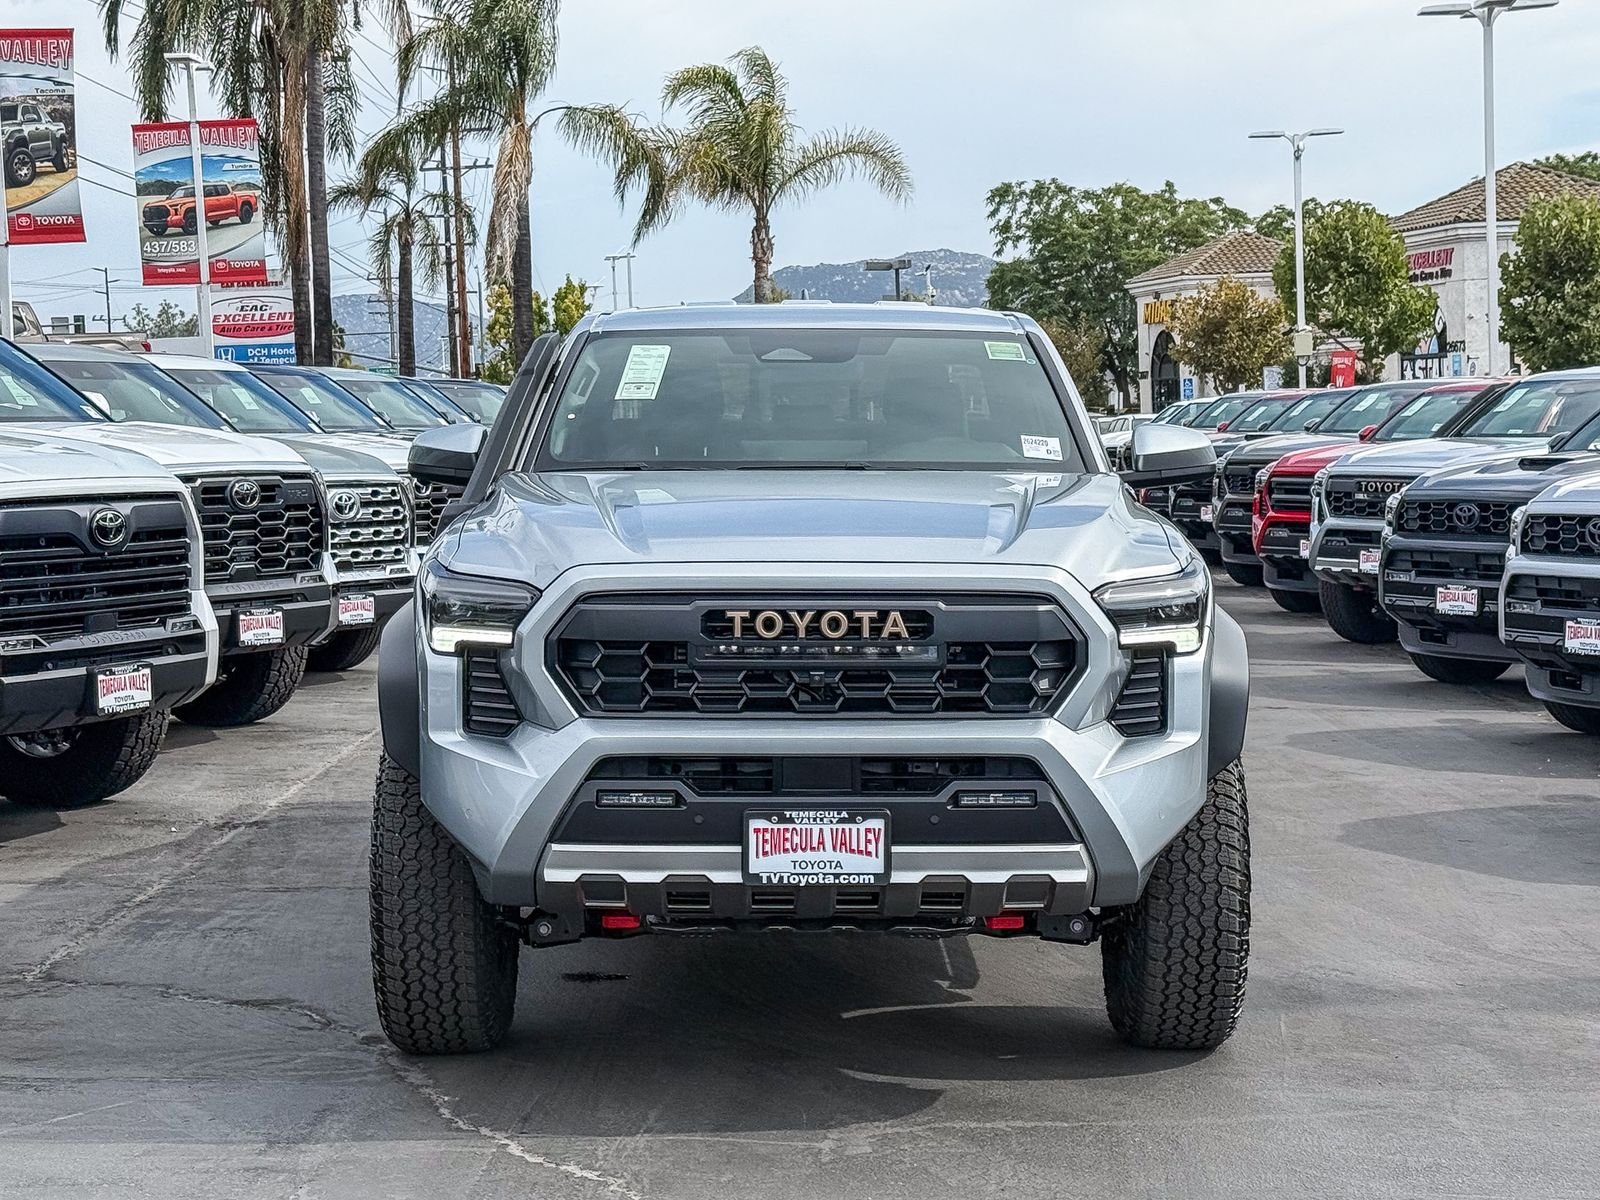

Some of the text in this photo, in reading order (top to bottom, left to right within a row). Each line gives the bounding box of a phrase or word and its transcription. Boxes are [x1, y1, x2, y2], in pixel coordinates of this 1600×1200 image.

[0, 39, 70, 70] VALLEY
[135, 129, 190, 155] TEMECULA
[200, 126, 255, 151] VALLEY
[35, 215, 76, 225] TOYOTA
[143, 240, 197, 253] 437/583
[229, 260, 260, 268] TOYOTA
[1407, 247, 1454, 270] EXCELLENT
[212, 311, 295, 323] EXCELLENT
[219, 325, 242, 333] Auto
[244, 325, 265, 333] Care
[247, 346, 296, 356] DCH Hond
[725, 610, 910, 639] TOYOTA
[100, 672, 150, 699] TEMECULA VALLEY
[114, 695, 135, 703] TOYOTA
[104, 702, 150, 714] TVToyota.com
[753, 827, 882, 859] TEMECULA VALLEY
[791, 860, 843, 870] TOYOTA
[759, 872, 875, 886] TVToyota.com
